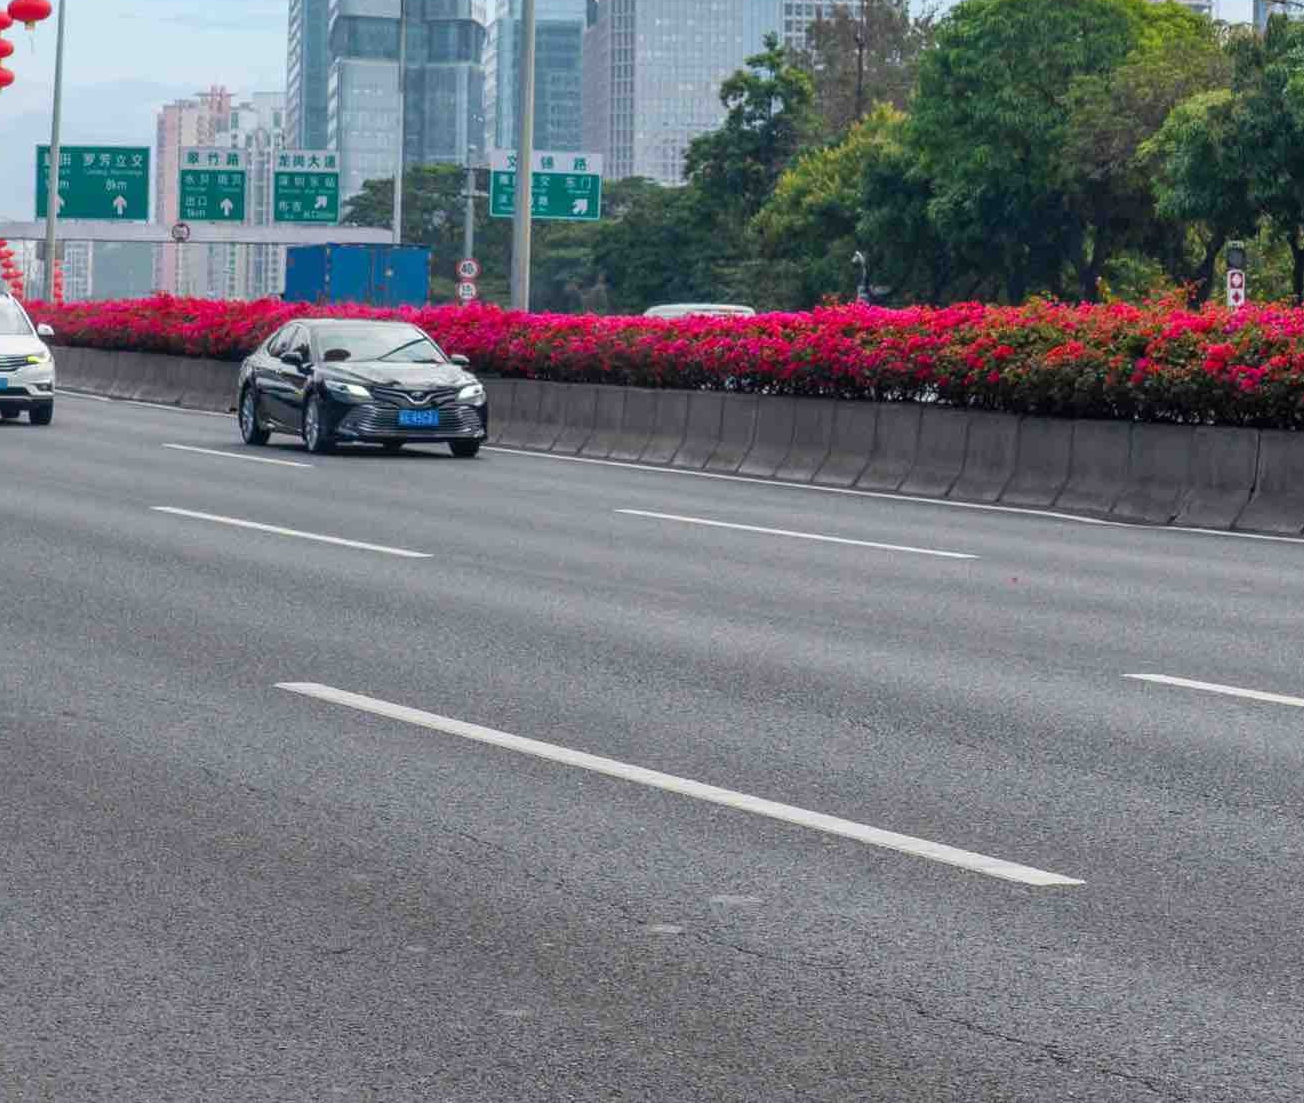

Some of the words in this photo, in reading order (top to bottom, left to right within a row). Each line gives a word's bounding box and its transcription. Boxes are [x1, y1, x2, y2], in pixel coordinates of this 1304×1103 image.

[279, 154, 336, 169] 龙岗大道
[461, 262, 475, 275] 40
